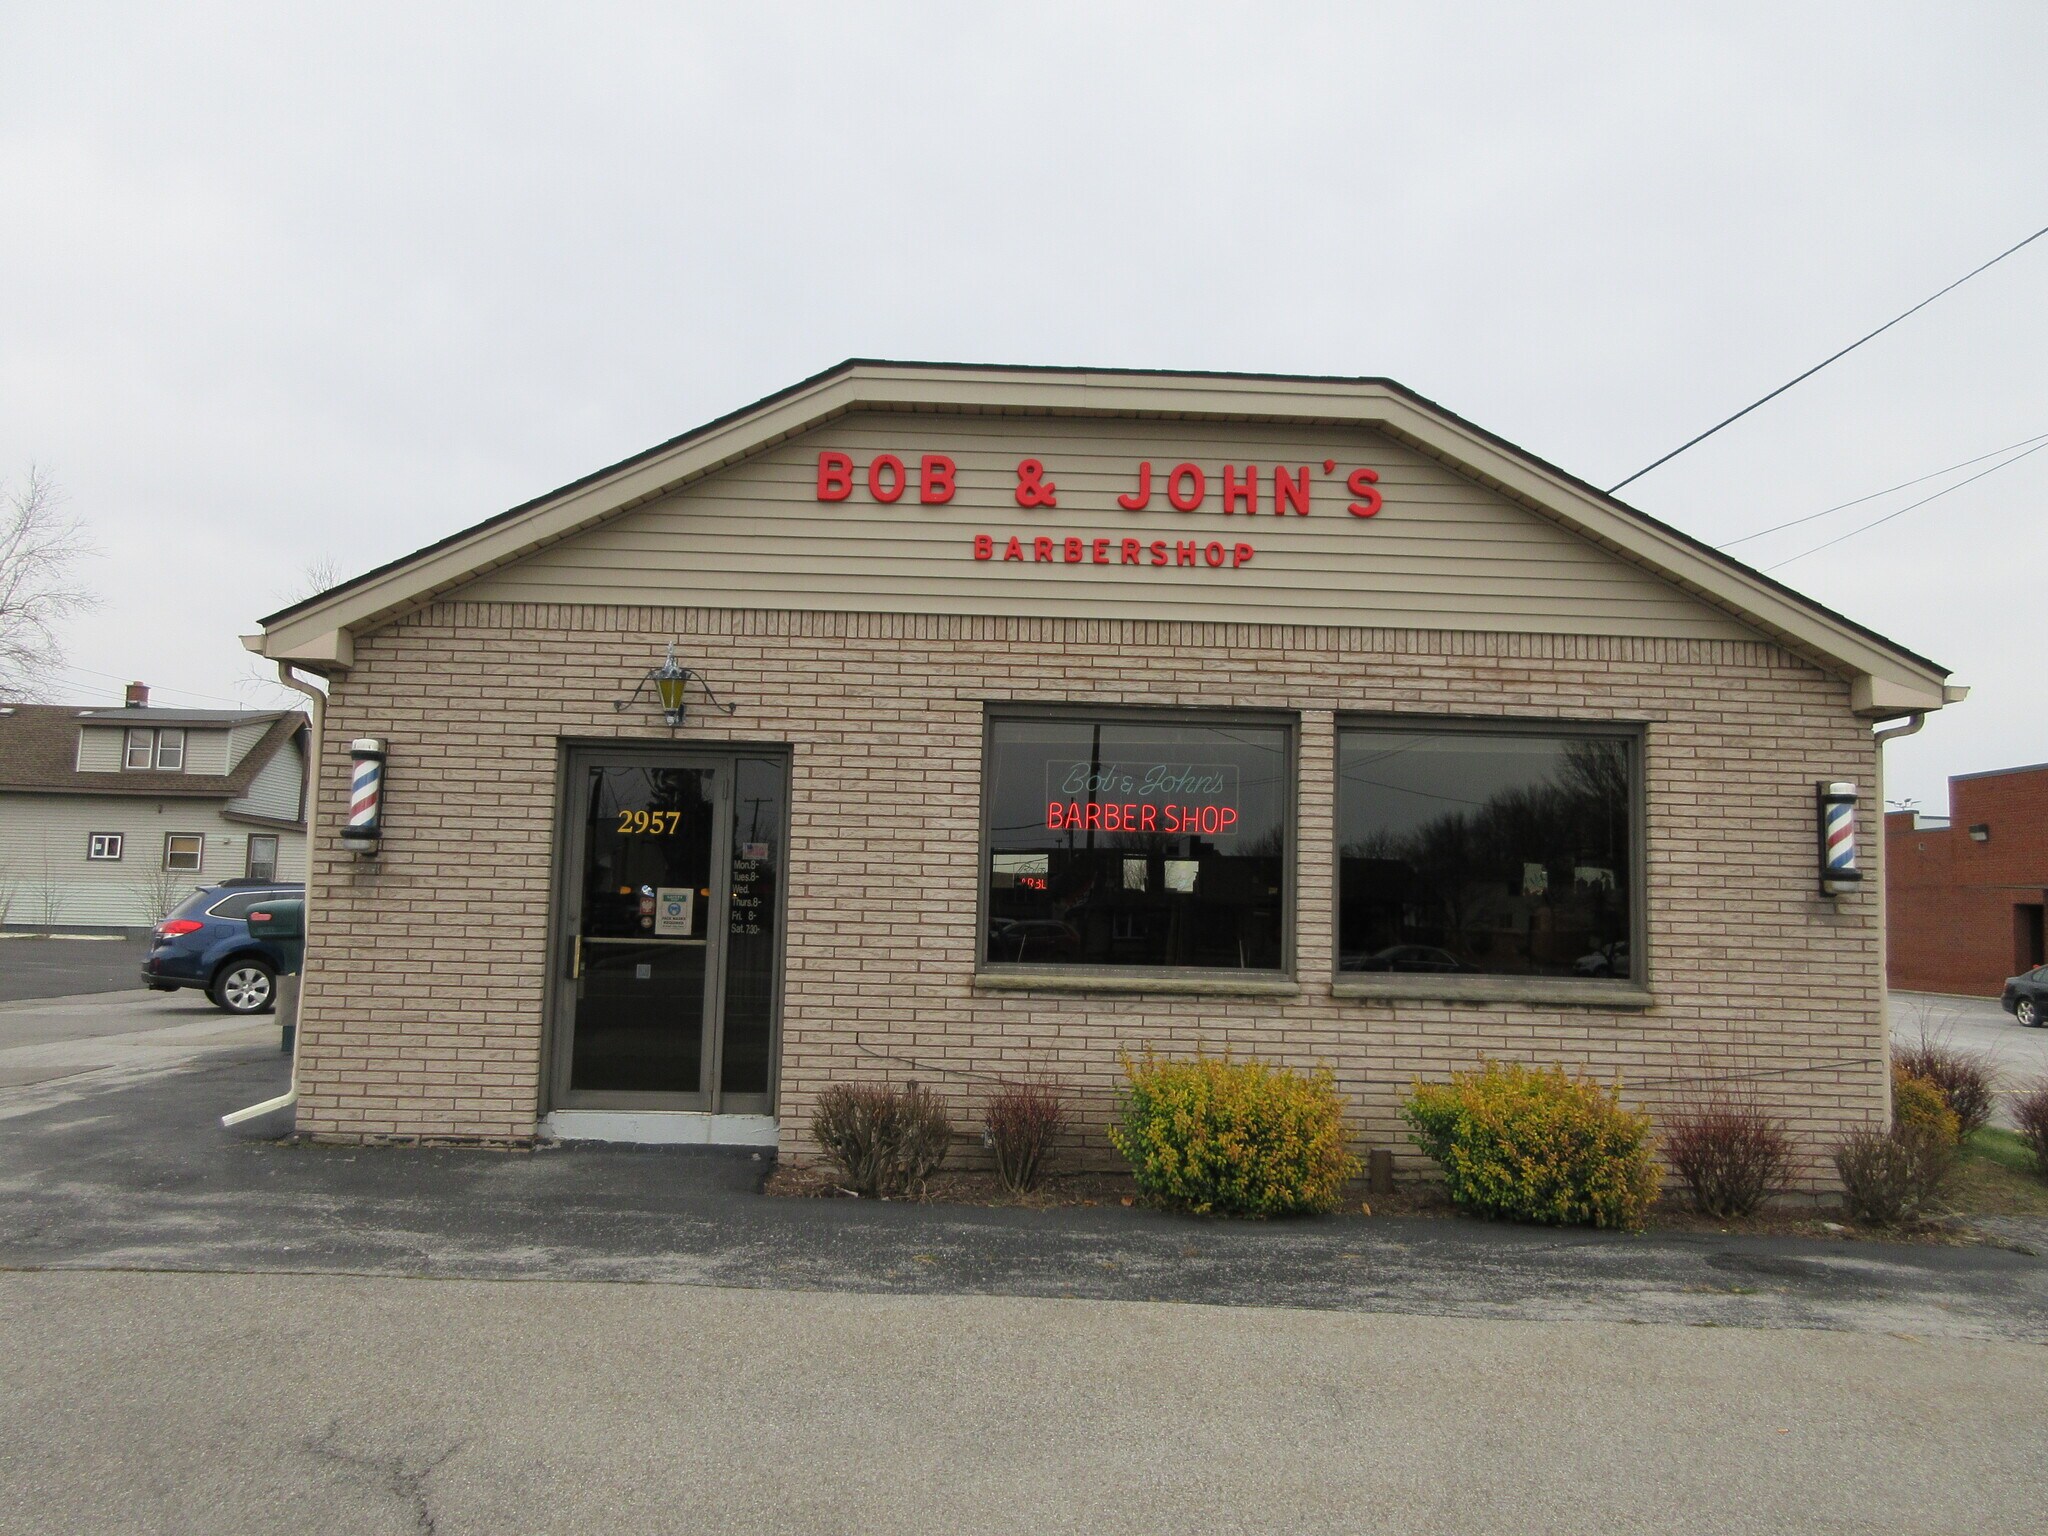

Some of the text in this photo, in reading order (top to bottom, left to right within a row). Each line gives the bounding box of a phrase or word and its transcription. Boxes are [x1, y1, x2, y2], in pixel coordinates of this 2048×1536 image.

[817, 452, 1383, 517] BOB & JOHN'S
[974, 533, 1254, 568] BARBERSHOP
[1062, 762, 1224, 796] Bob & John's
[617, 809, 681, 834] 2957
[1047, 802, 1239, 834] BARBER SHOP
